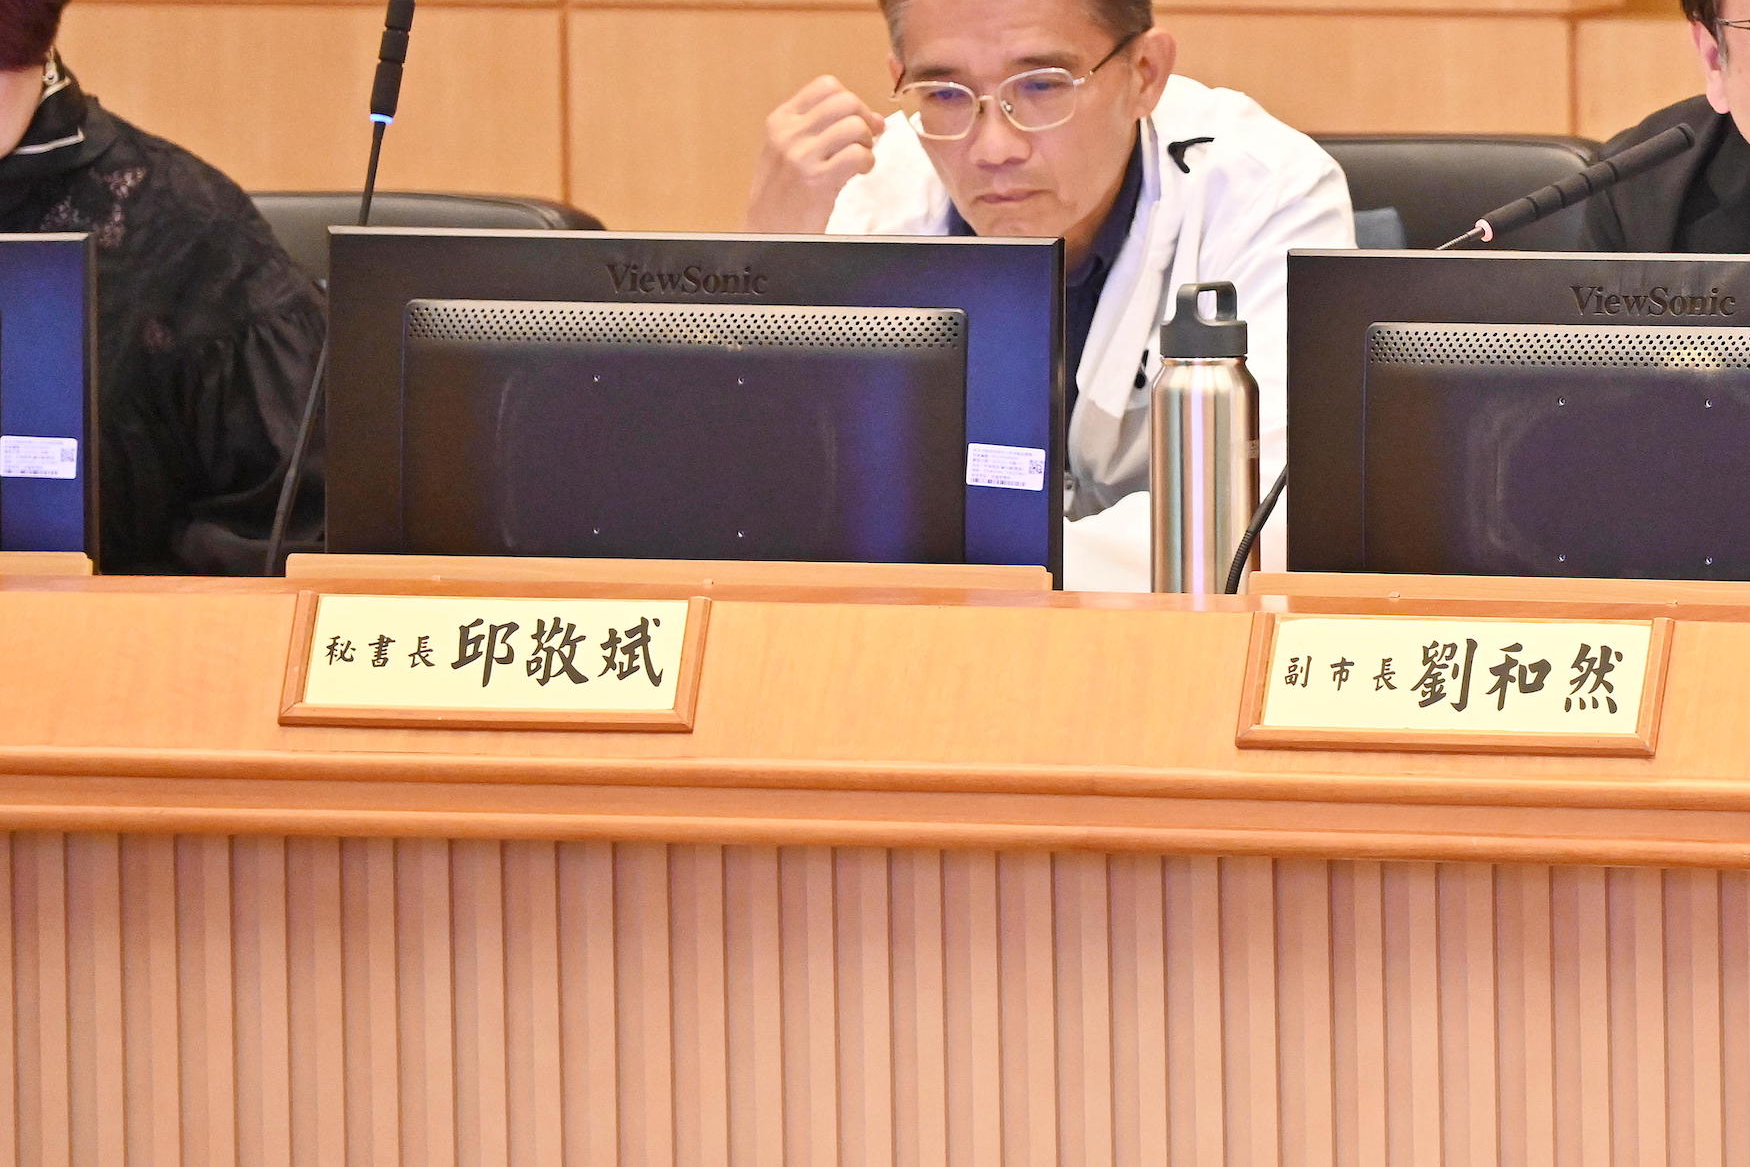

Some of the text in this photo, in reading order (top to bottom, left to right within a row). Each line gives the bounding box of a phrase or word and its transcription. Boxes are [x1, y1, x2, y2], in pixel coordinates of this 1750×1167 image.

[606, 264, 769, 295] ViewSonic
[1570, 285, 1737, 317] ViewSonic
[450, 616, 664, 688] 邱敬斌
[1284, 638, 1624, 714] 副市長 劉和然
